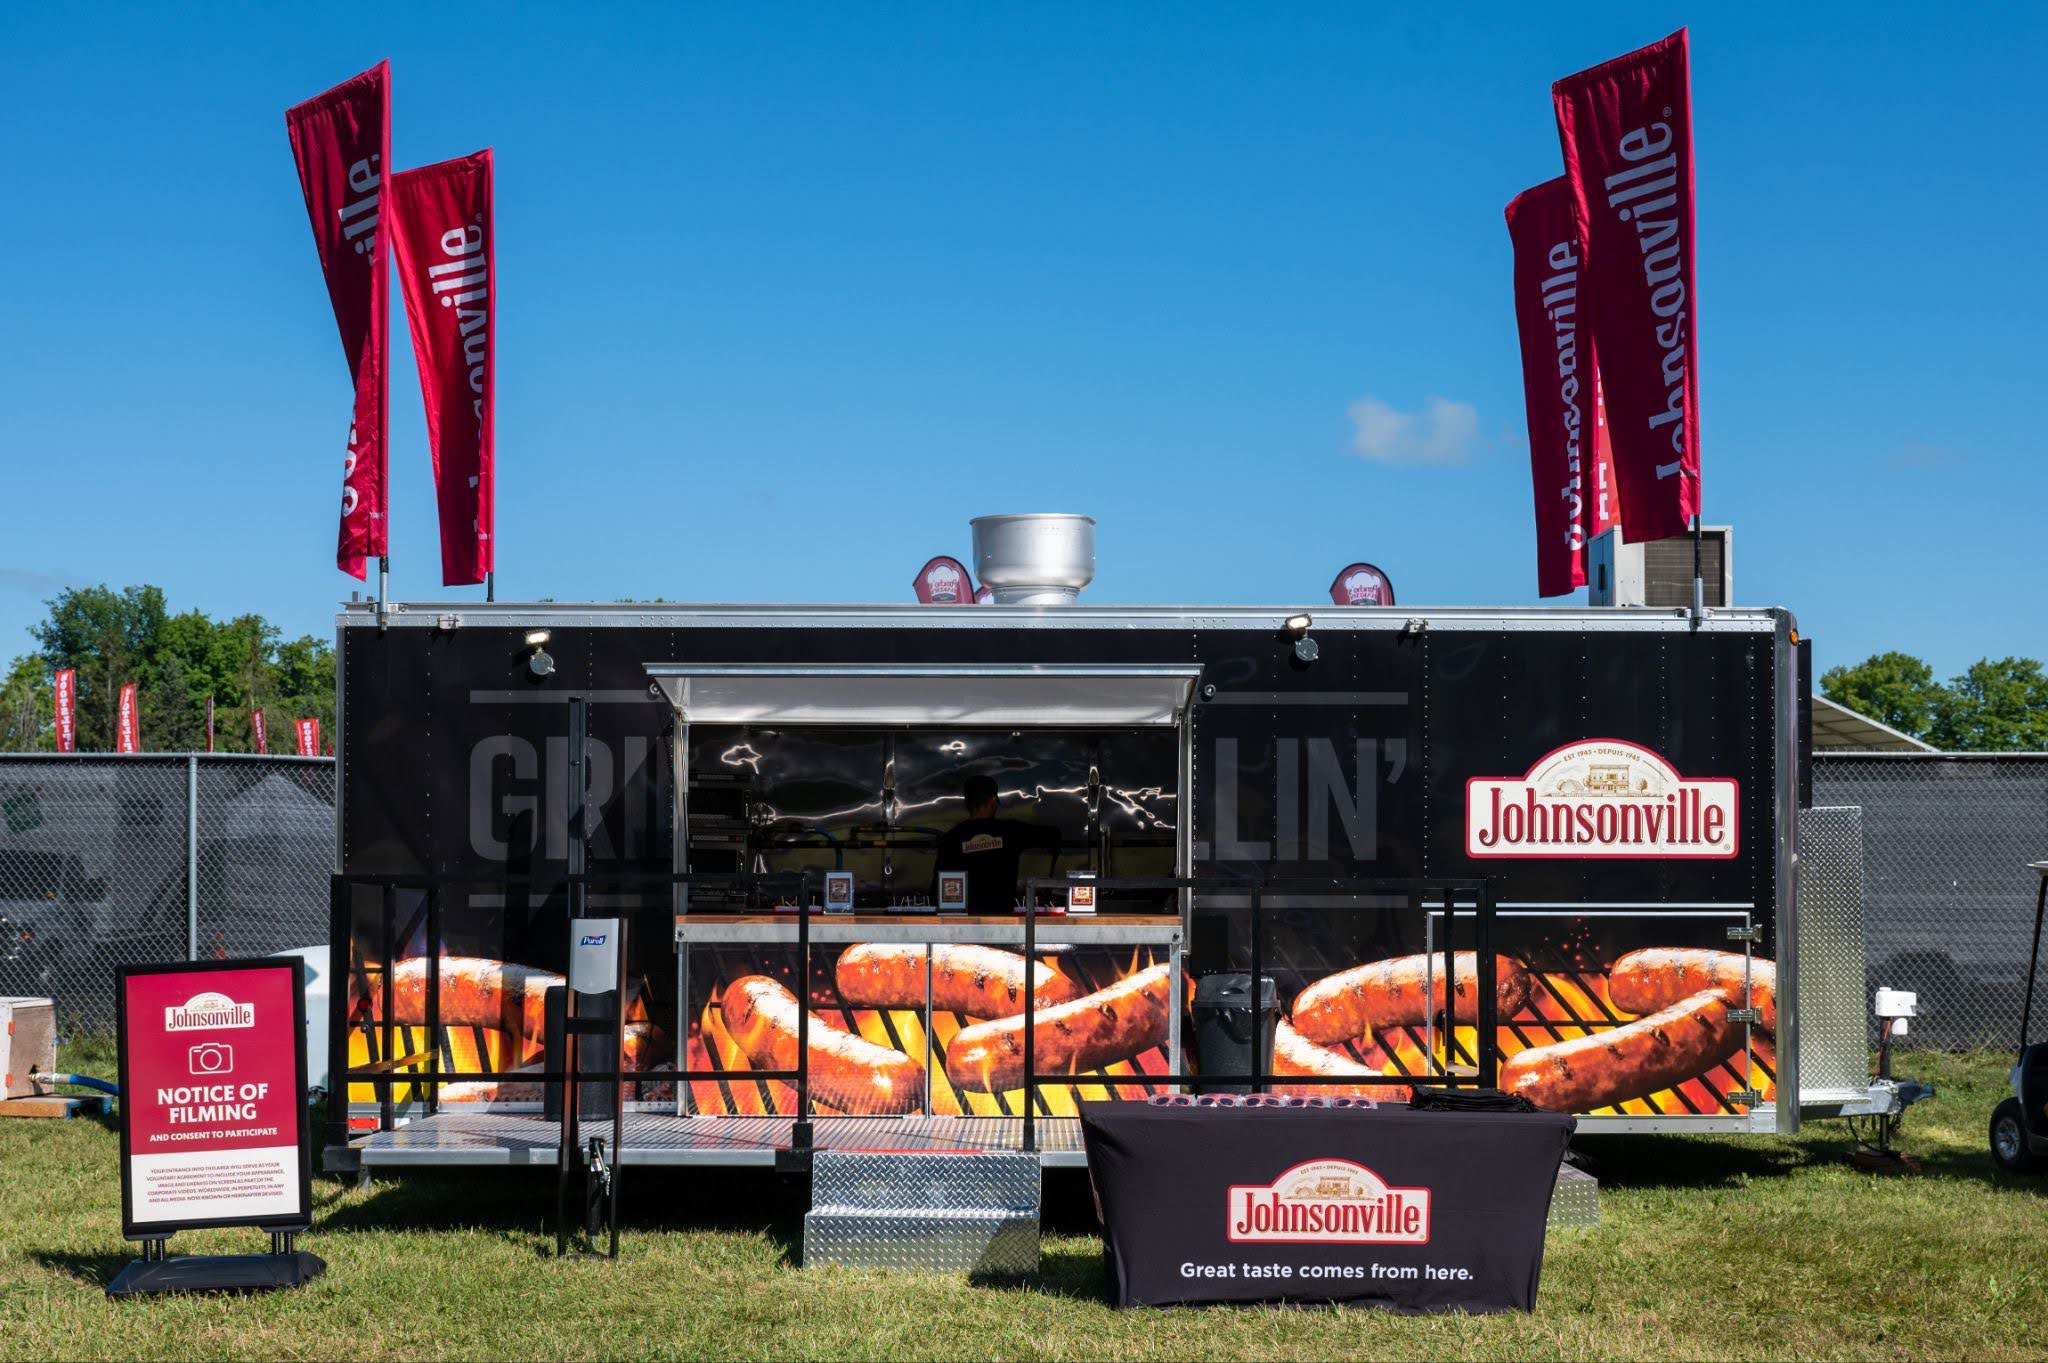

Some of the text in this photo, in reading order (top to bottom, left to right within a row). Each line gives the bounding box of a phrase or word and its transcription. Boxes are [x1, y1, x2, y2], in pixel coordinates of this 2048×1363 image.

[470, 735, 1407, 861] GRI LIN'
[1478, 787, 1726, 847] Johnsonville
[169, 1005, 251, 1029] Johnsonville
[157, 1083, 268, 1105] NOTICE OF
[169, 1103, 257, 1124] FILMING
[150, 1127, 278, 1142] AND CONSENT TO PARTICIPATE
[1236, 1191, 1420, 1235] Johnsonville
[1180, 1262, 1474, 1281] Great taste comes from here.
